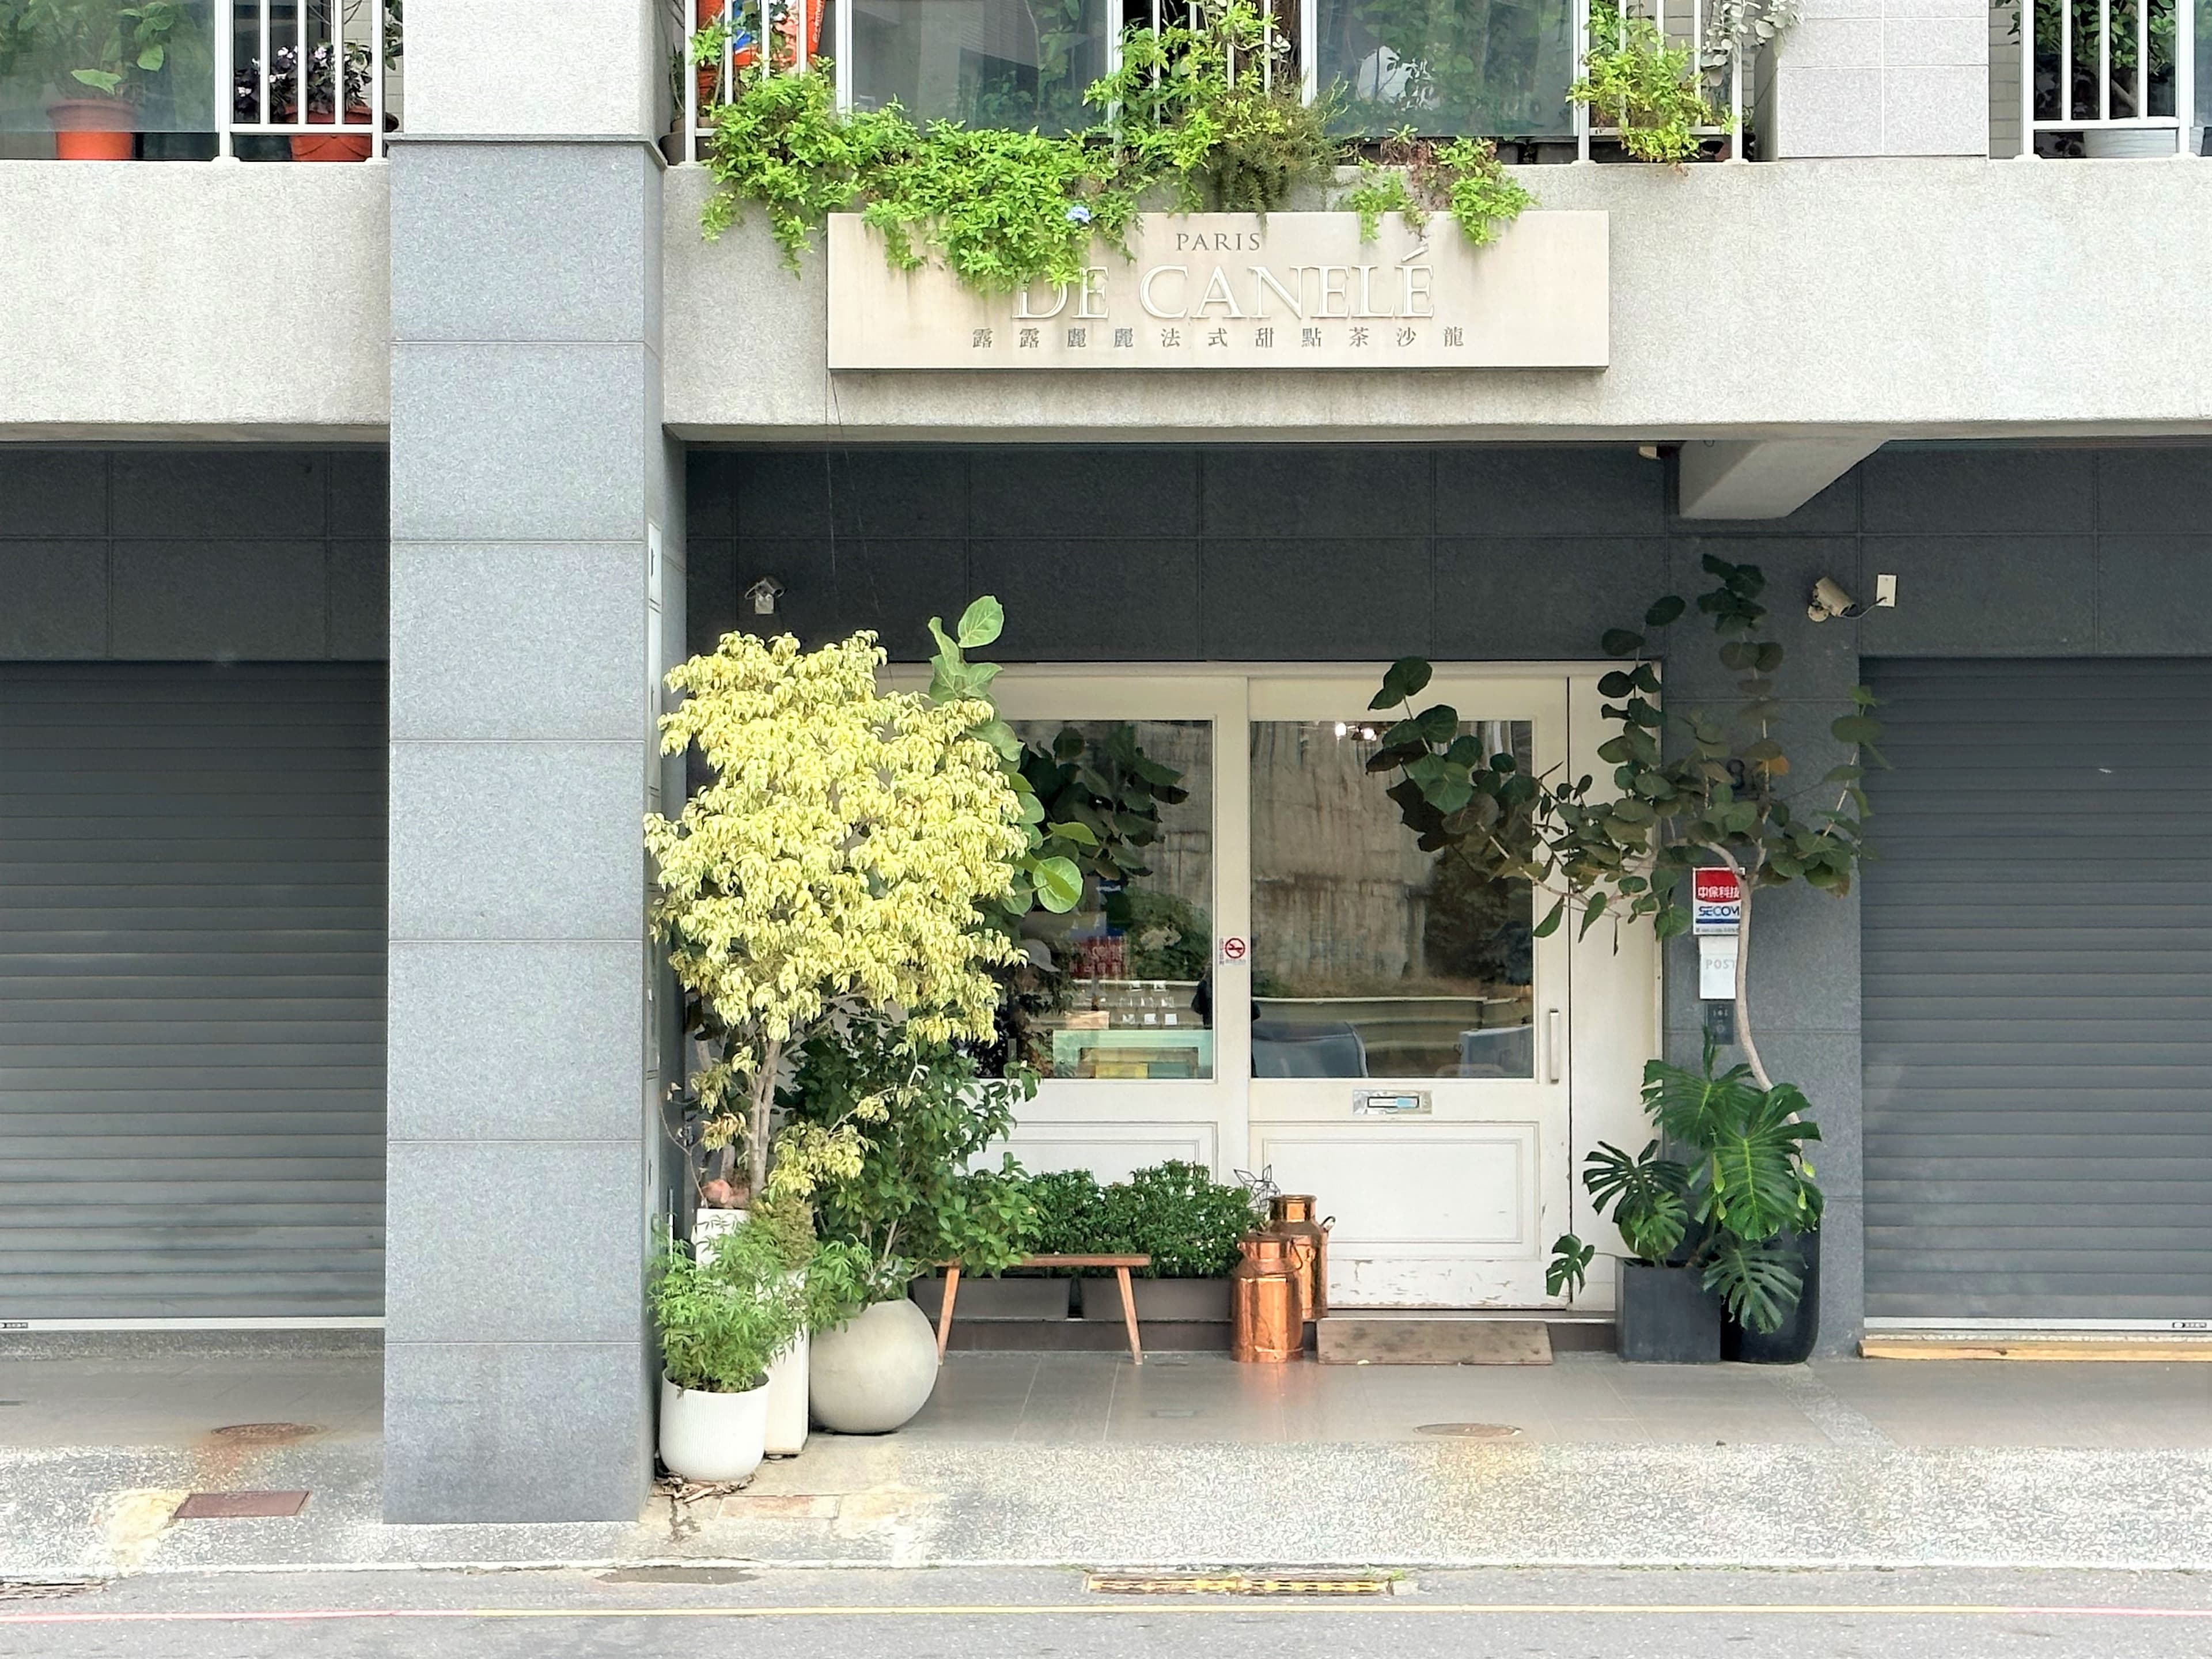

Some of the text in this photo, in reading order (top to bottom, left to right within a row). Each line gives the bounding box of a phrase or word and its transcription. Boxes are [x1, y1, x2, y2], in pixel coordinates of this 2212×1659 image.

[1176, 232, 1260, 251] PARIS
[1011, 244, 1434, 319] DE CANELÉ
[972, 327, 1464, 348] 露露麗麗法式甜點茶沙龍
[1698, 906, 1740, 916] SECOM
